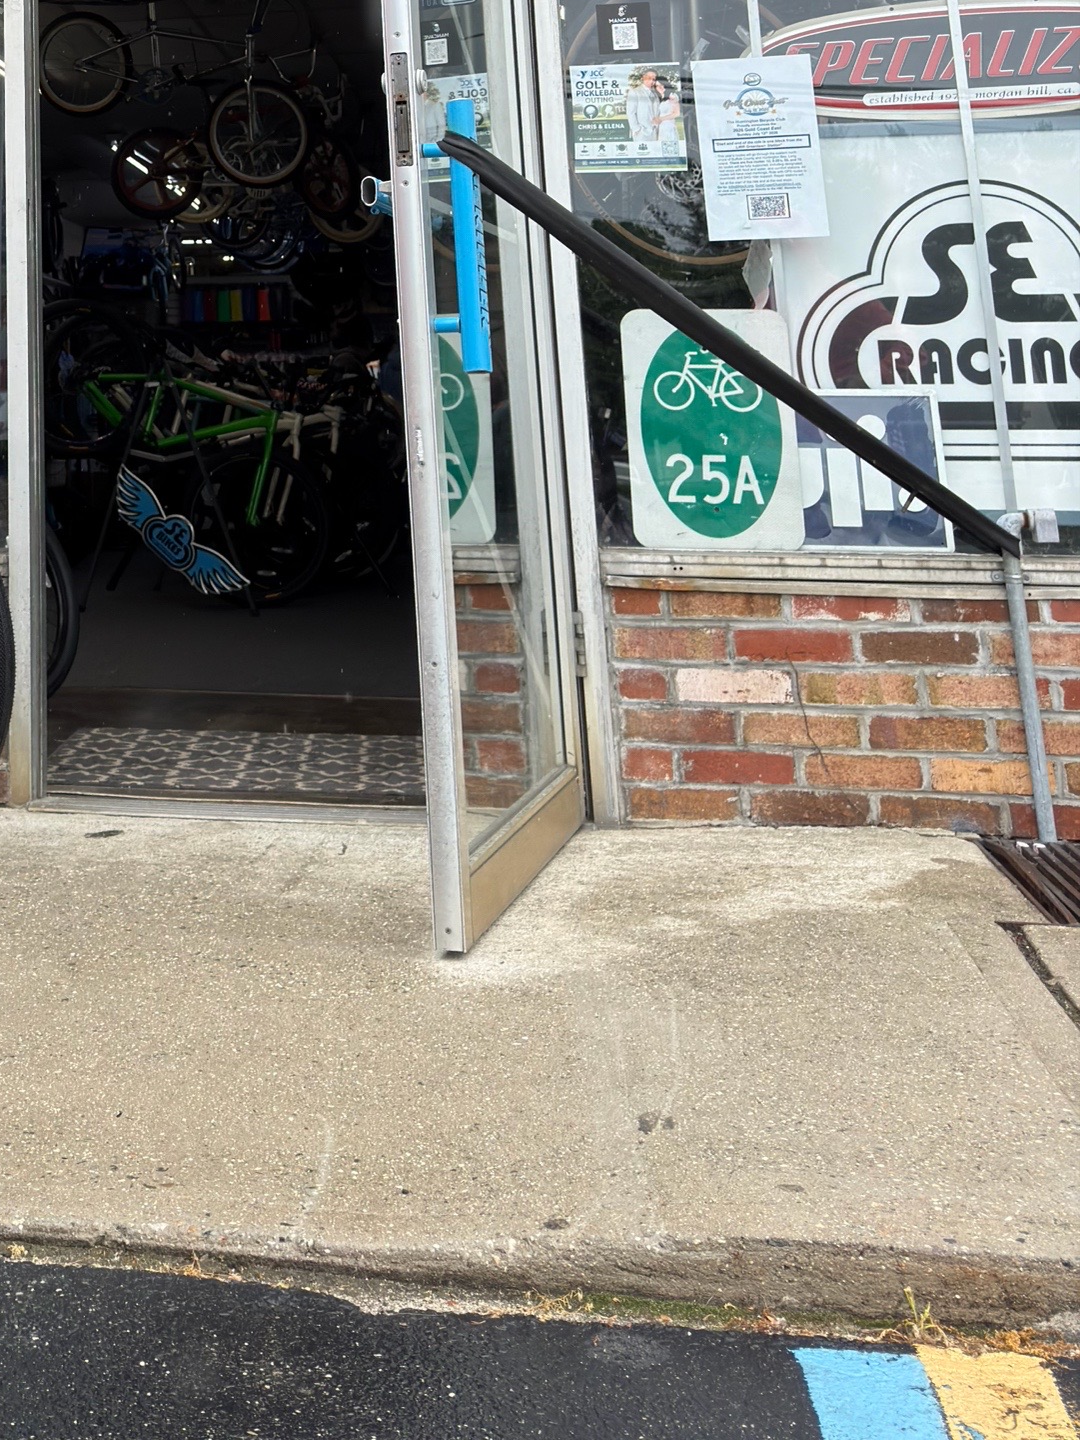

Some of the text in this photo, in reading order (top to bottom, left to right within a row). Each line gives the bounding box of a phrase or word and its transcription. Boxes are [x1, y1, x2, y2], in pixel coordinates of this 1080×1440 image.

[608, 16, 638, 24] MANCAVE
[589, 69, 605, 77] JCC
[575, 79, 620, 89] GOLF &
[575, 89, 624, 97] PICKLEBALL
[868, 92, 934, 105] established
[975, 90, 1023, 101] morgan
[901, 220, 1078, 326] SE
[665, 453, 765, 506] 25A
